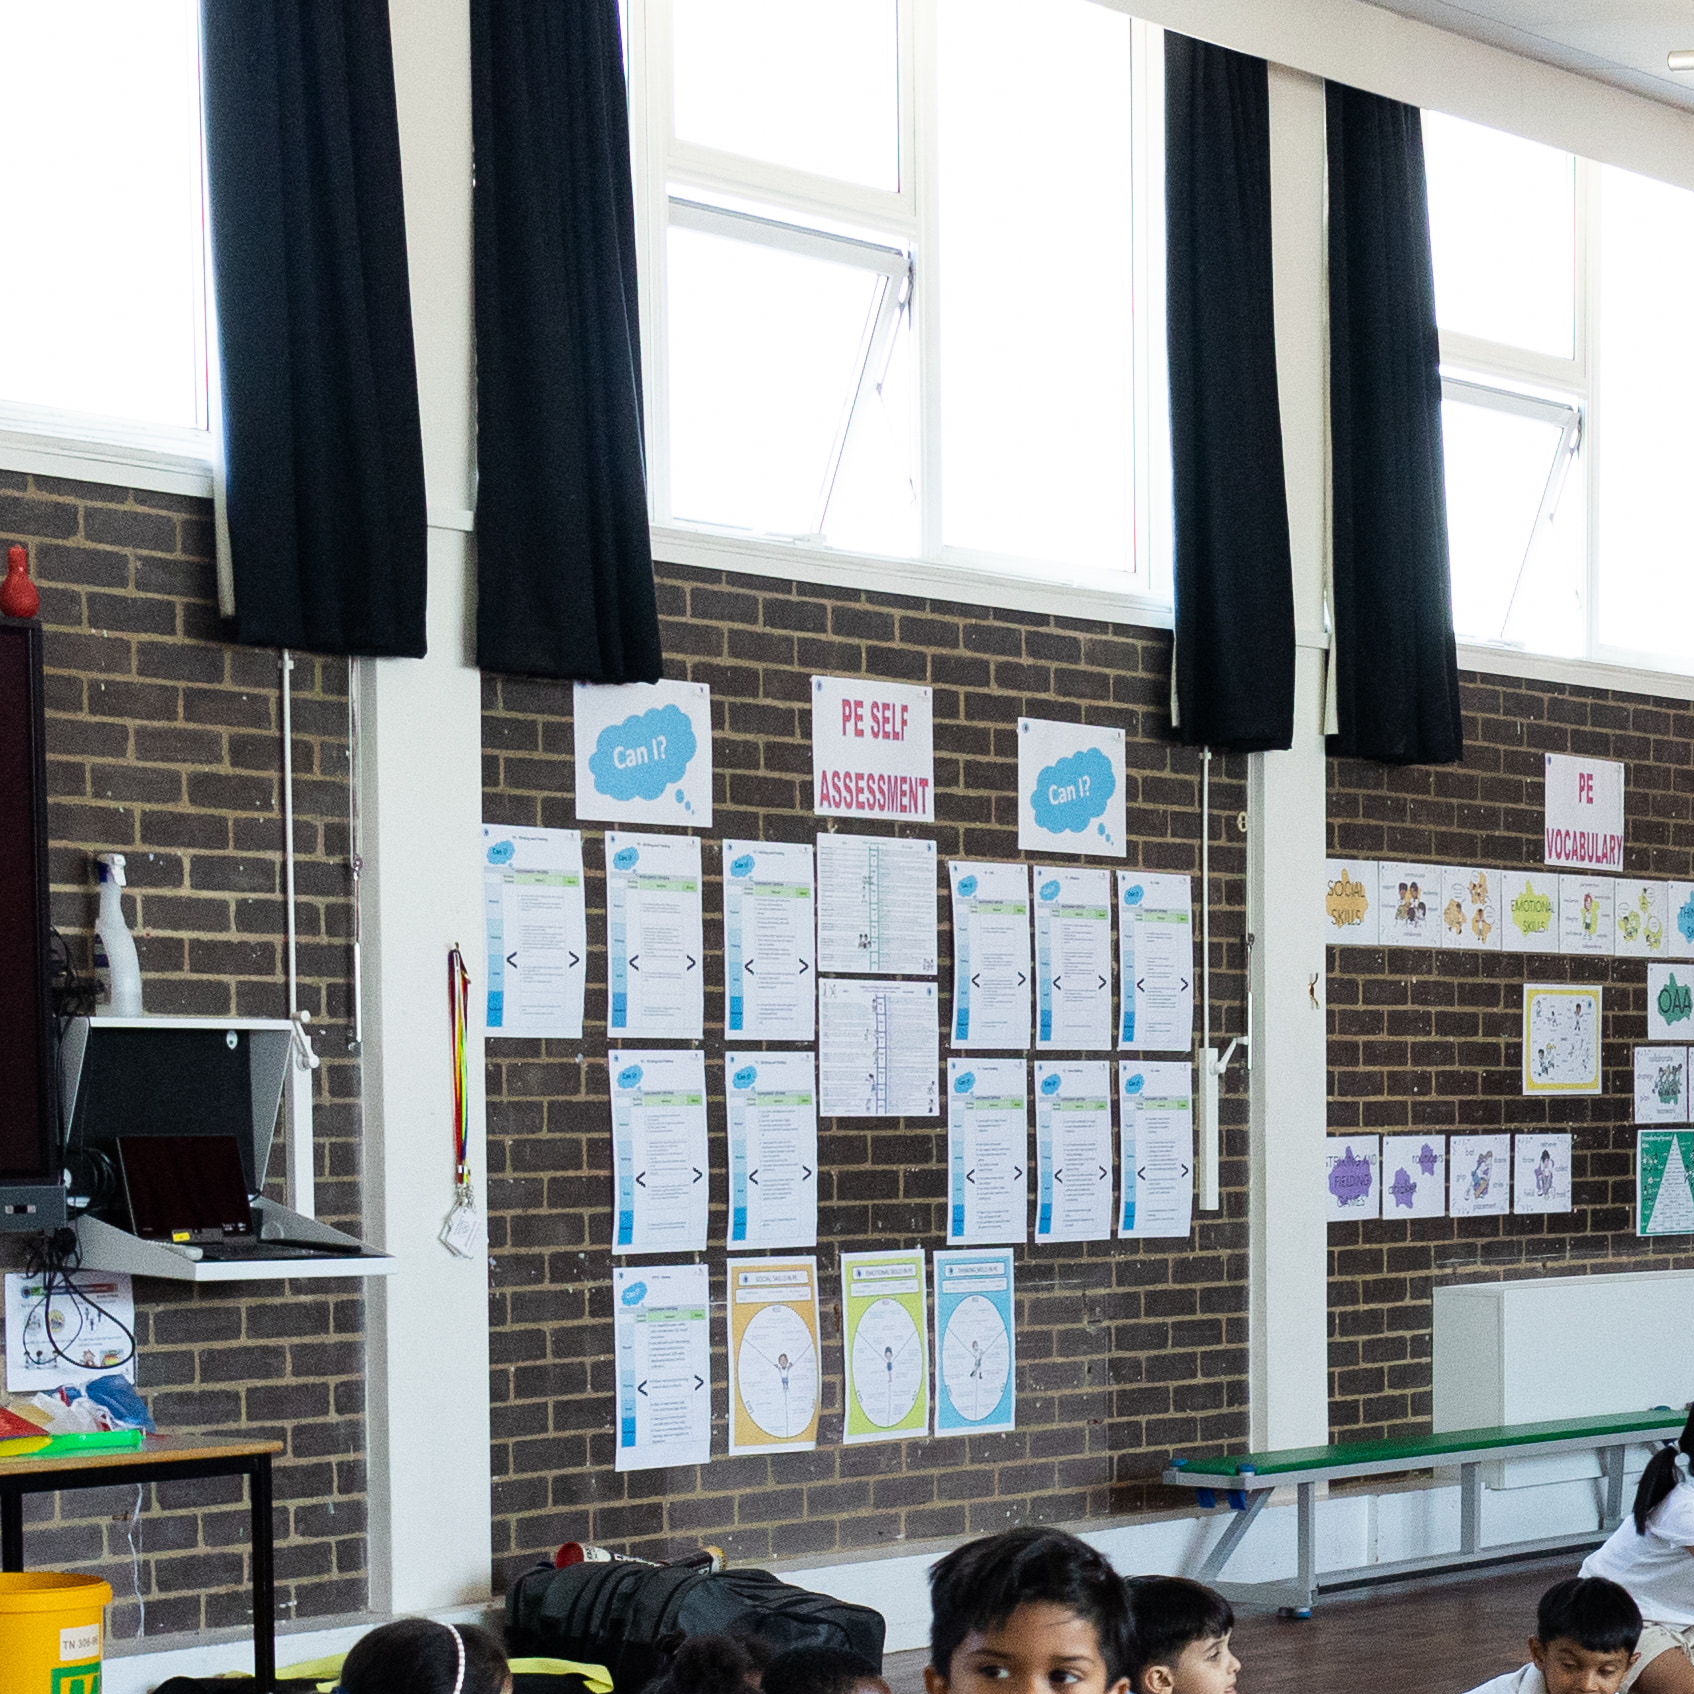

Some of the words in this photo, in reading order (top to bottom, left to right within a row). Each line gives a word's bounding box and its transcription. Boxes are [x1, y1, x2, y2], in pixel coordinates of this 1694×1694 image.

[842, 699, 864, 737] PE
[870, 702, 908, 741] SELF
[613, 745, 649, 770] Can
[652, 735, 667, 760] I?
[819, 769, 929, 815] ASSESSMENT
[1048, 783, 1076, 806] Can
[1078, 775, 1091, 797] I?
[1578, 772, 1594, 804] PE
[1546, 827, 1624, 866] VOCABULARY
[1327, 880, 1366, 898] SOCIAL
[1511, 899, 1556, 913] EMOTIONAL
[1331, 908, 1363, 927] SKILLS
[1522, 919, 1546, 934] SKILLS
[1658, 989, 1692, 1014] OAA
[1335, 1174, 1371, 1188] FIELDING
[1337, 1195, 1366, 1208] GAMES
[62, 1640, 76, 1650] TN
